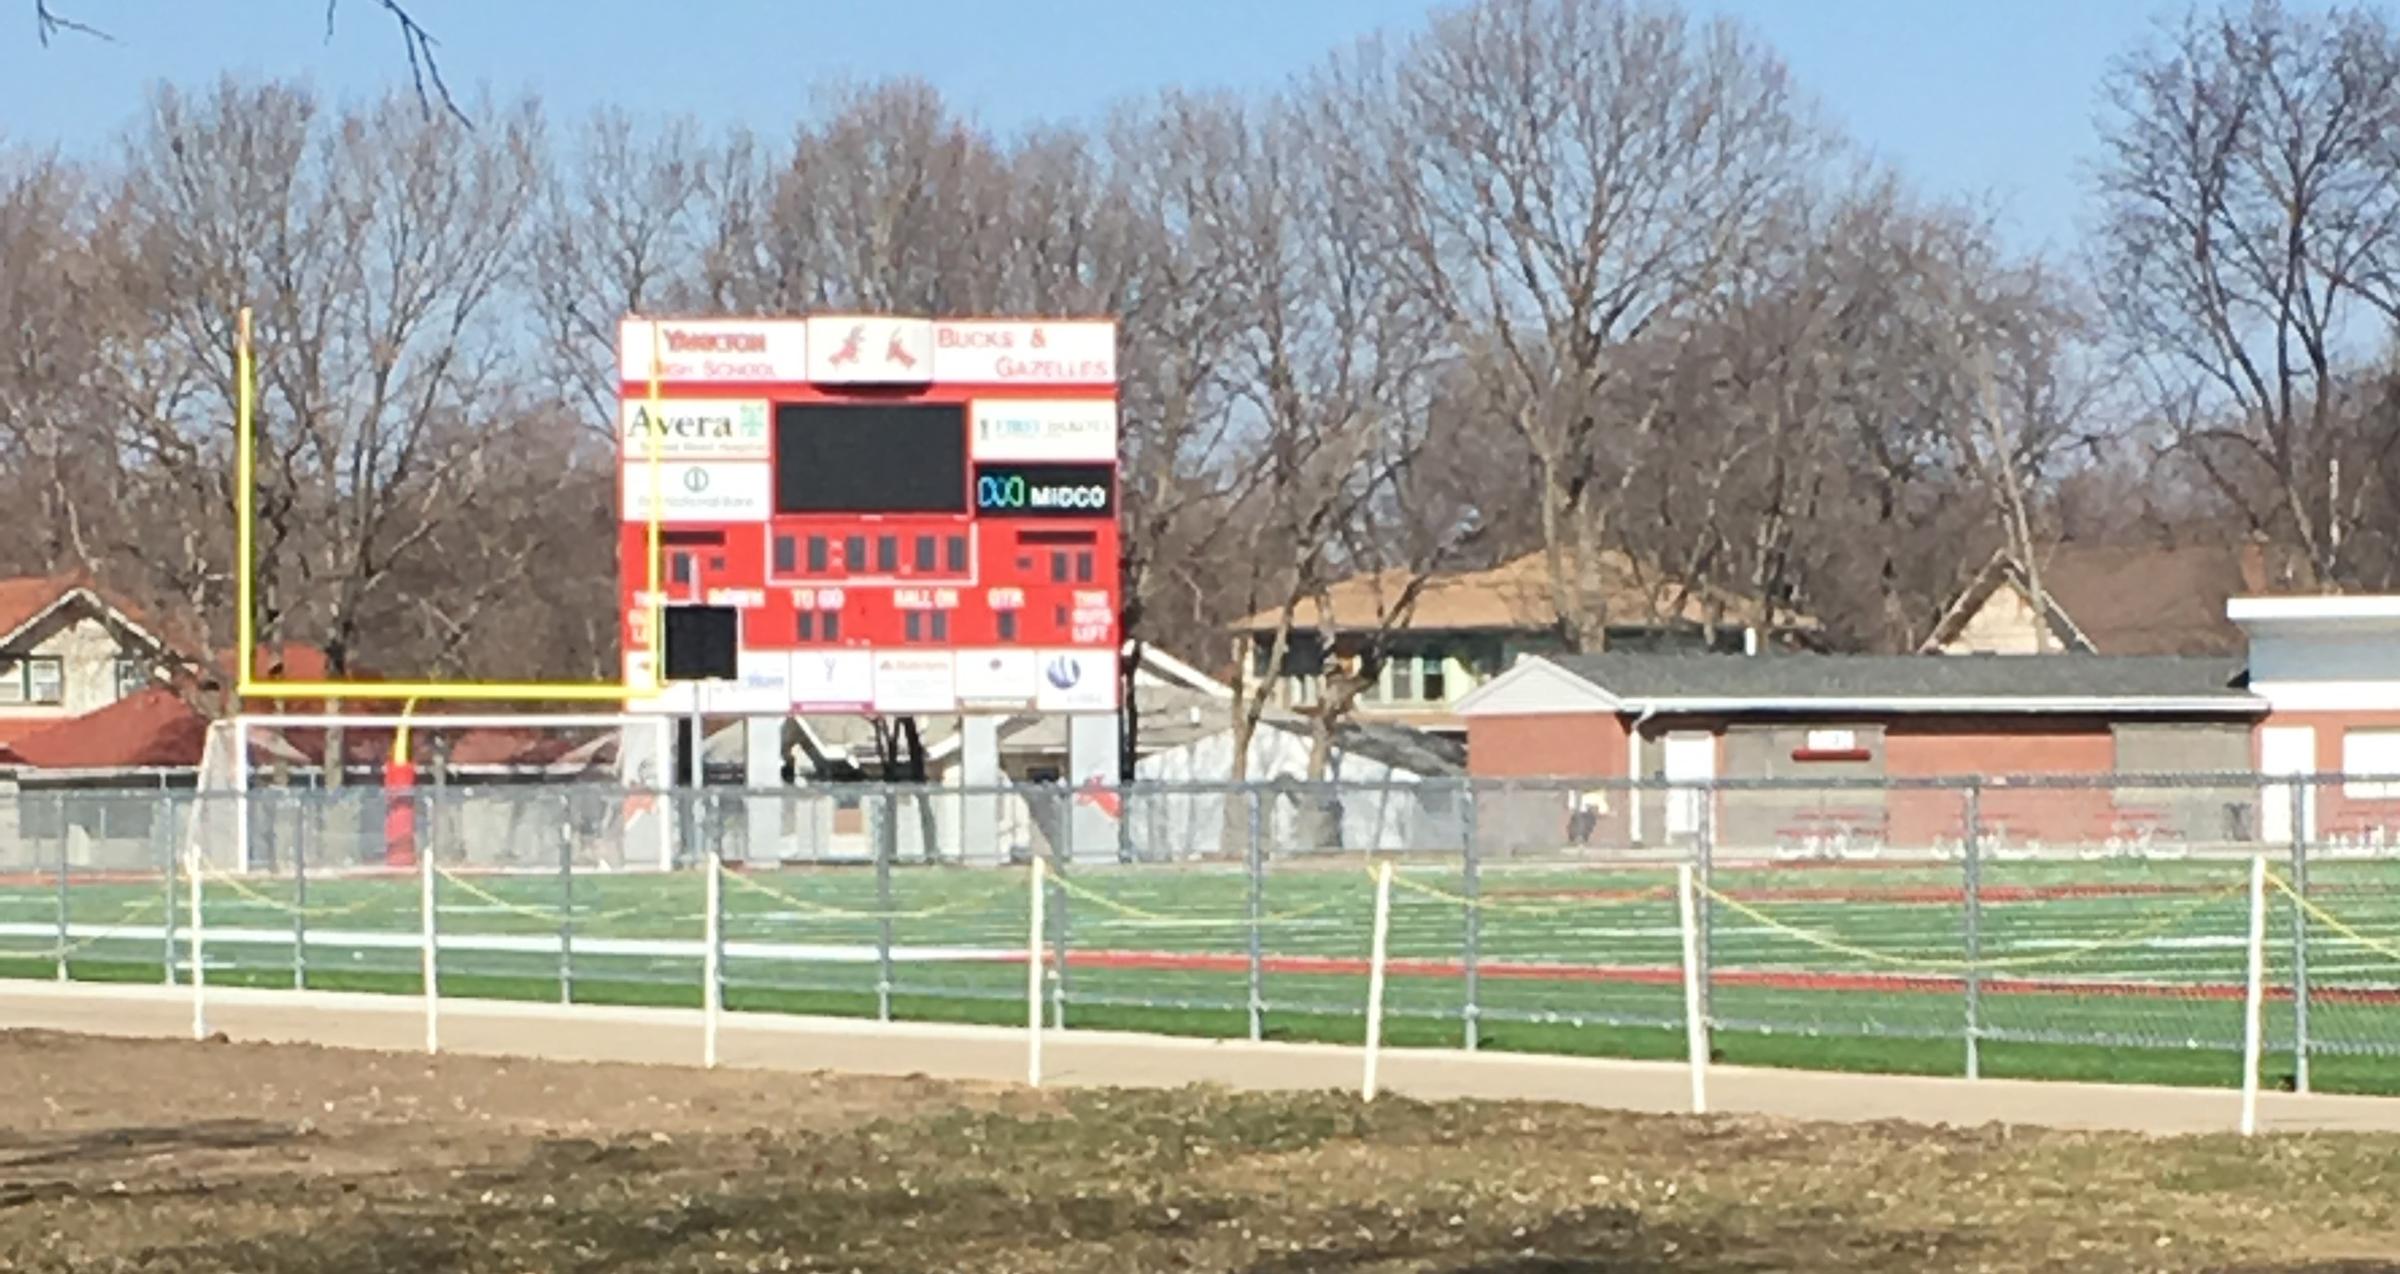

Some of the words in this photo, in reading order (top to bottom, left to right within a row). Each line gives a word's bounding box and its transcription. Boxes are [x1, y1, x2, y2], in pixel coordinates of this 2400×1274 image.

[1030, 328, 1046, 348] &
[627, 405, 733, 437] Avera
[791, 589, 814, 609] TO
